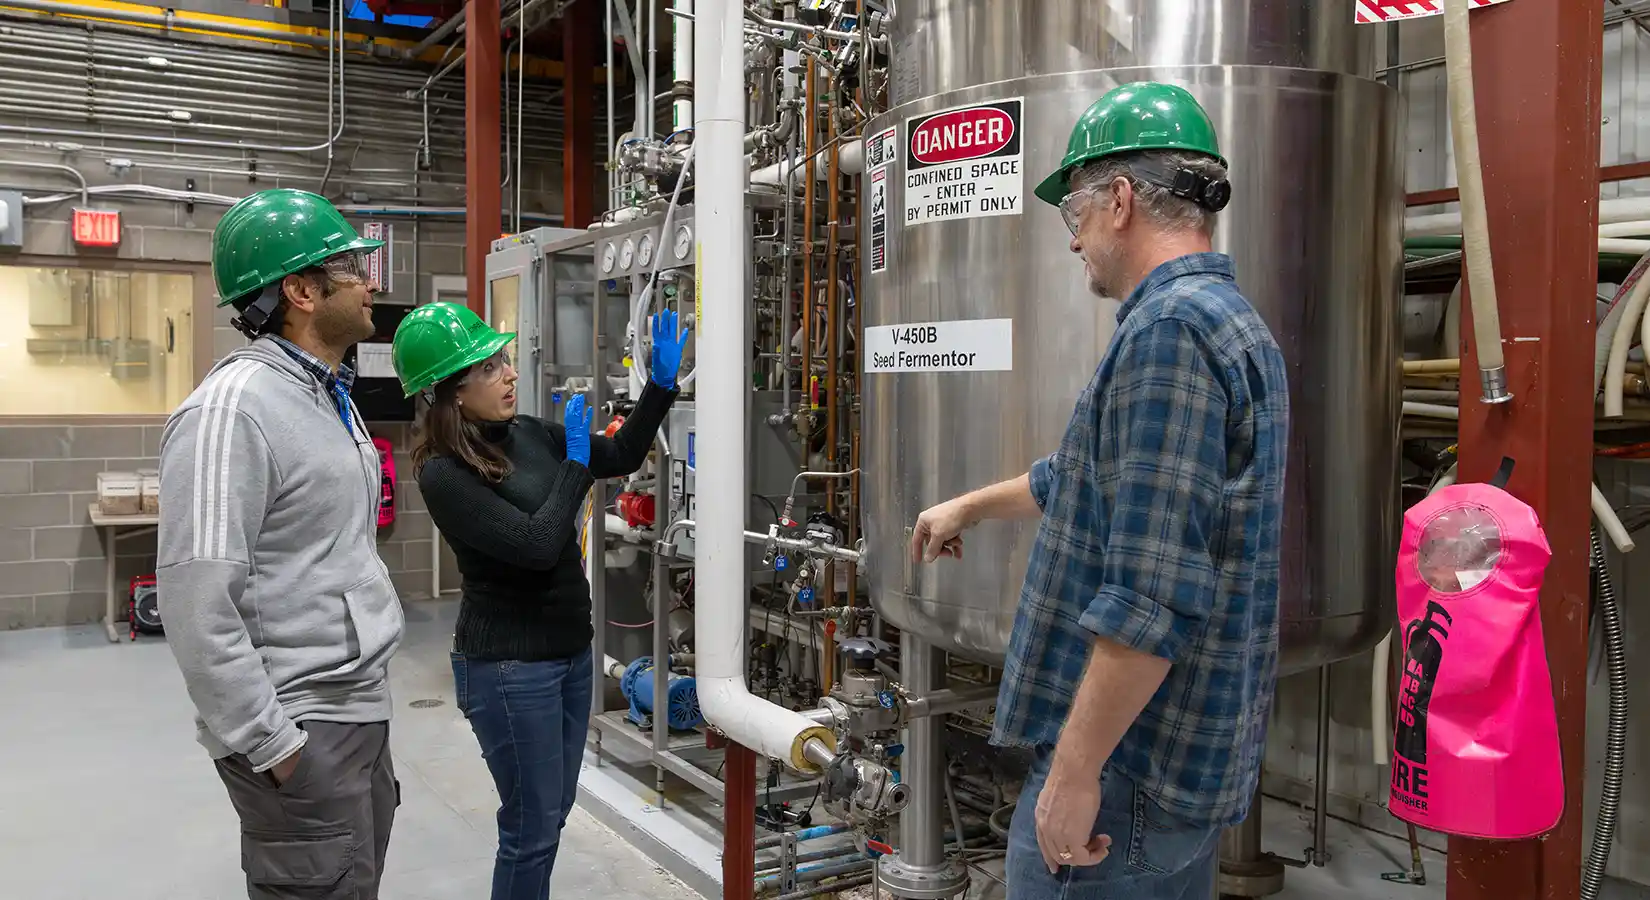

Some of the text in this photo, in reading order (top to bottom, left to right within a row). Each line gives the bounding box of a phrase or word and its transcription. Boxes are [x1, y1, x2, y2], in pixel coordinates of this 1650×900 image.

[917, 117, 1004, 156] DANGER
[907, 160, 1019, 188] CONFINED SPACE
[937, 182, 976, 200] ENTER
[907, 195, 1017, 221] BY PERMIT ONLY
[77, 212, 117, 240] EXIT
[892, 326, 938, 345] V-450B
[873, 350, 976, 368] Seed Fermentor
[1413, 662, 1423, 679] A
[1410, 678, 1420, 694] B
[1407, 695, 1416, 711] C
[1406, 711, 1415, 727] D
[1391, 756, 1429, 799] IRE
